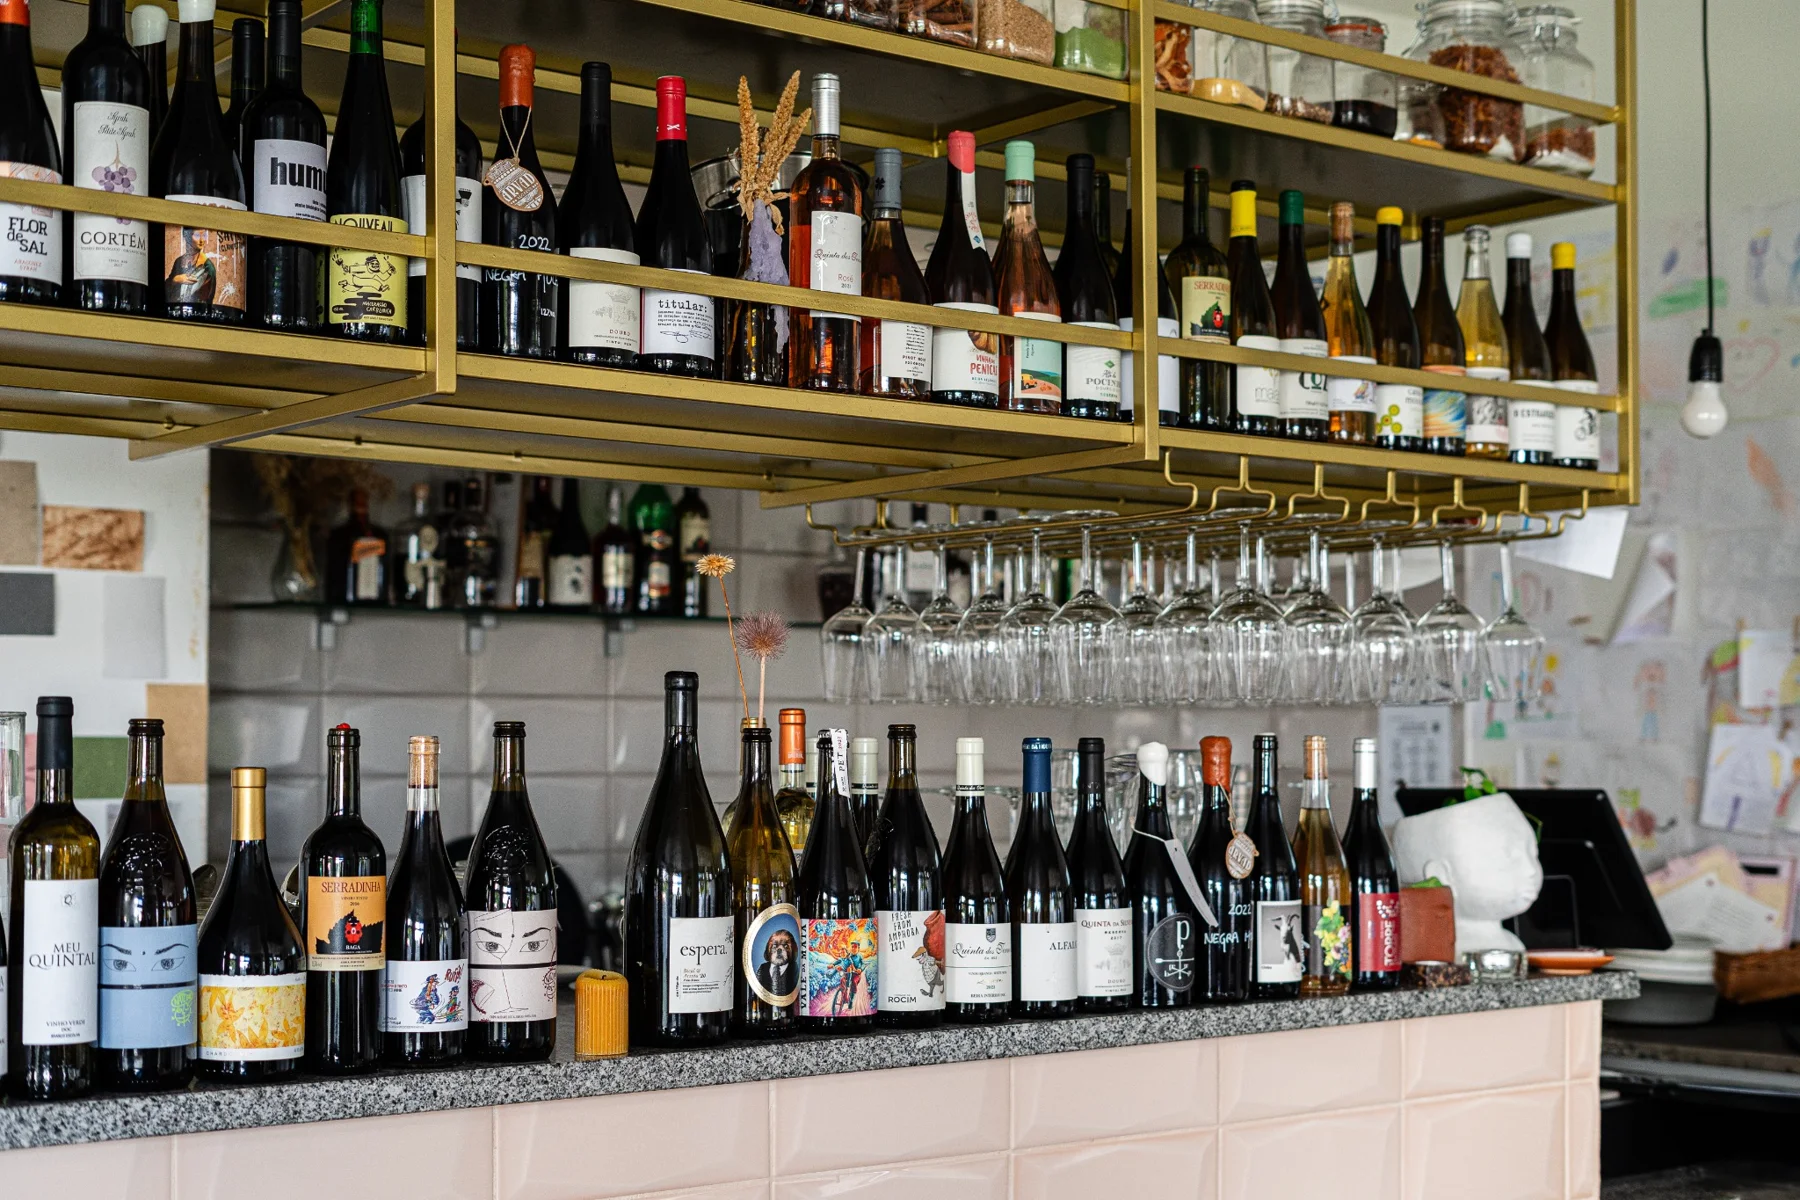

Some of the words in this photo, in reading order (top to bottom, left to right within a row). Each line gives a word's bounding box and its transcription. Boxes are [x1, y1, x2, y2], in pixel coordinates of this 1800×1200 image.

[8, 217, 48, 236] FLOR
[7, 229, 23, 241] de
[81, 231, 146, 251] CORTÉM
[518, 234, 552, 251] 2022
[19, 239, 48, 256] SAL
[838, 273, 853, 283] Rosé
[658, 299, 708, 313] titular:
[837, 752, 845, 771] PET
[321, 881, 381, 893] SERRADINHA
[891, 911, 912, 922] FRESH
[1228, 905, 1252, 915] 2022
[893, 919, 912, 932] FROM
[1081, 919, 1111, 928] QUINTA
[53, 942, 81, 954] MEU
[1204, 931, 1240, 953] NEGRA
[680, 944, 728, 966] espera.
[952, 942, 985, 958] Quinta
[29, 952, 96, 970] QUINTAL
